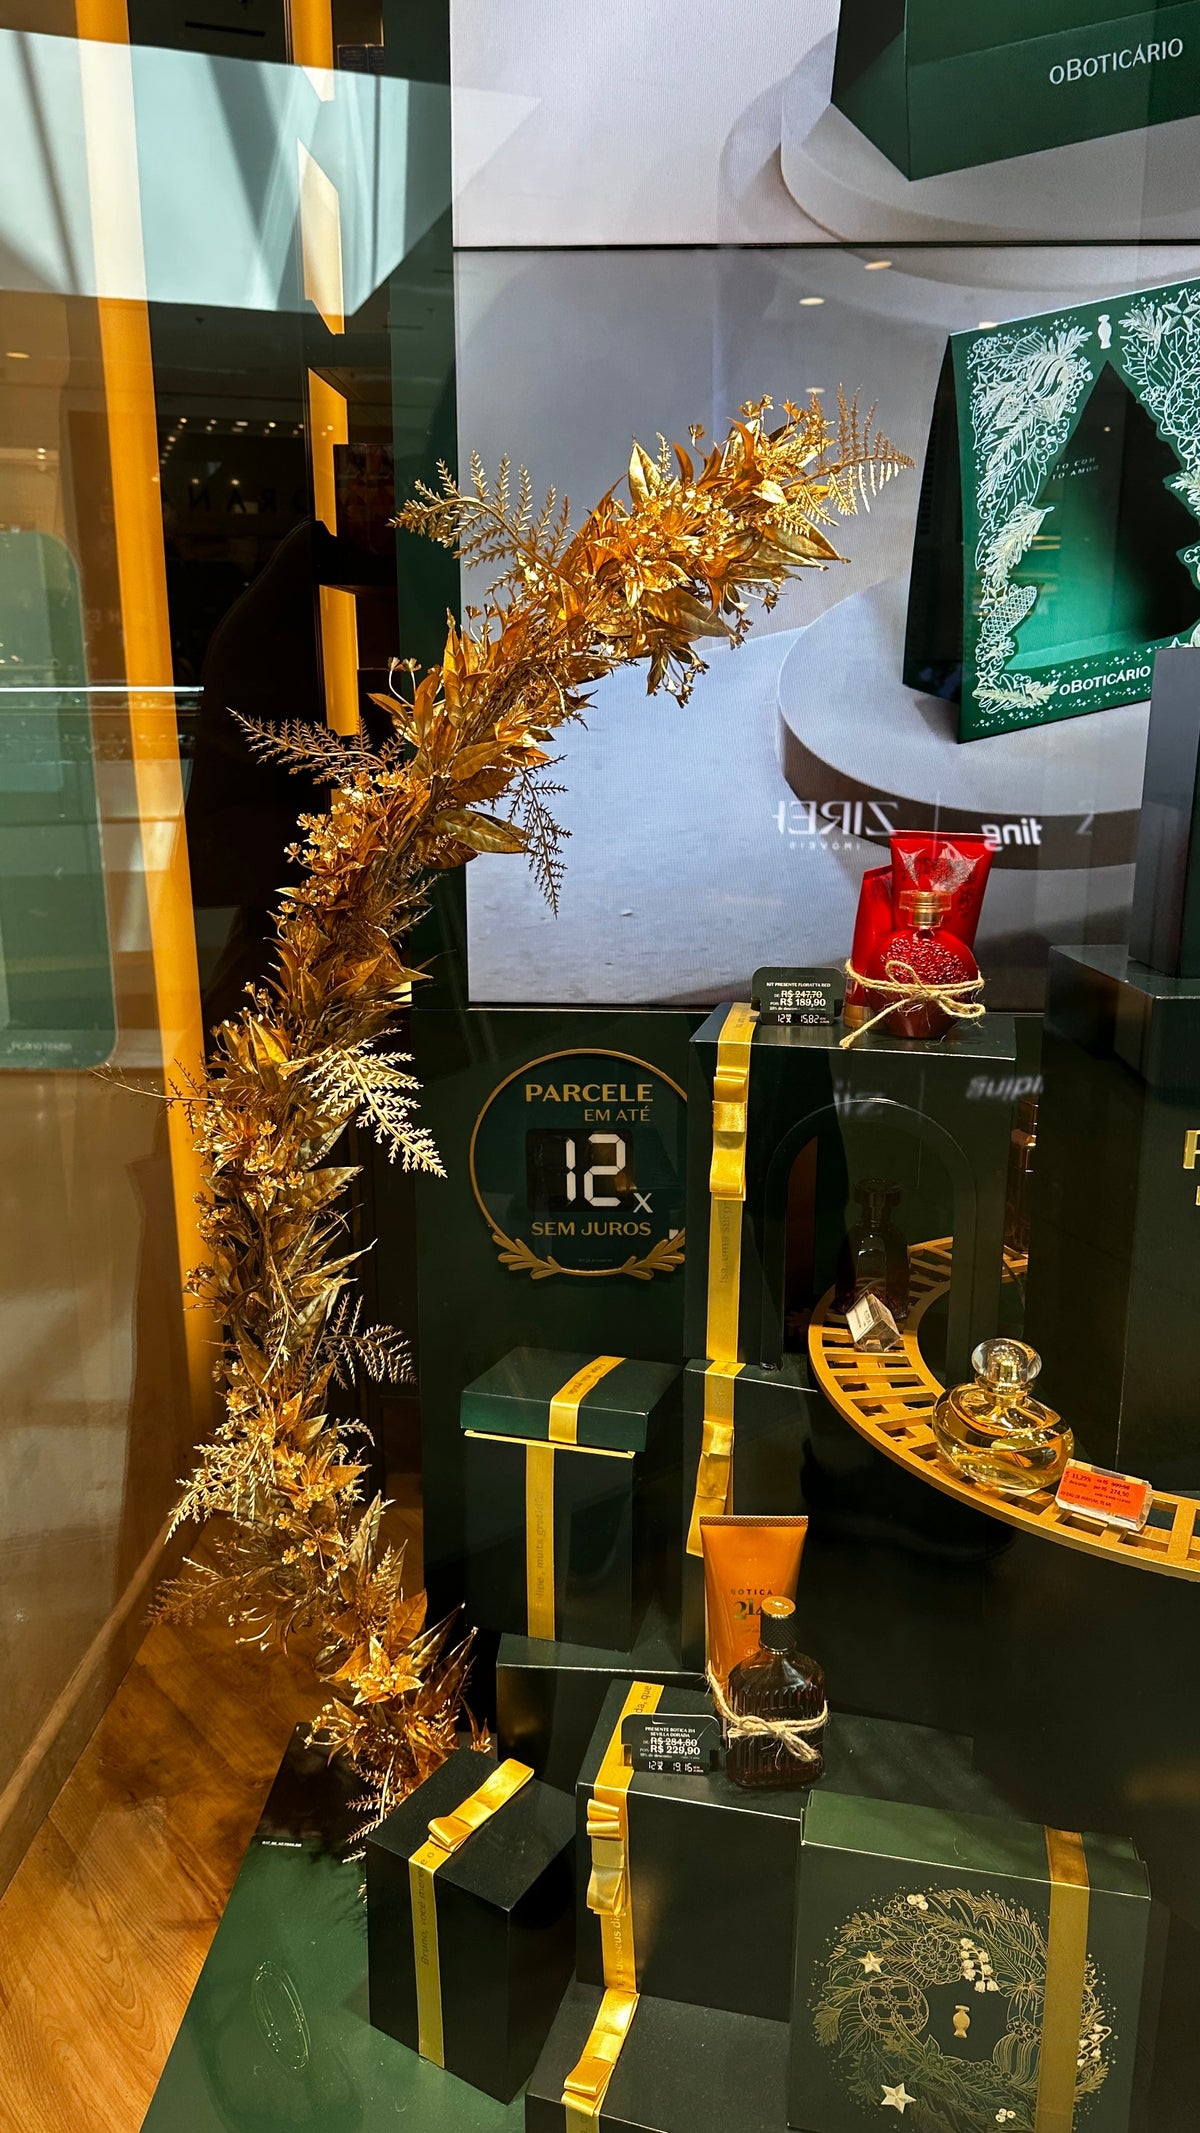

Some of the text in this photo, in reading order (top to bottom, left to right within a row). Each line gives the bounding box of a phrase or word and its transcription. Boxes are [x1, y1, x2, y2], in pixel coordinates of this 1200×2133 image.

[781, 990, 793, 999] R$
[795, 990, 823, 999] 247,70
[780, 998, 793, 1007] R$
[795, 998, 826, 1008] 189,90
[525, 1083, 653, 1103] PARCELE
[584, 1105, 651, 1122] EM ATÉ
[531, 1221, 652, 1236] SEM JUROS
[641, 1685, 652, 1700] que
[650, 1737, 664, 1745] R$
[665, 1737, 698, 1747] 284,80
[650, 1745, 664, 1754] R$
[666, 1745, 701, 1756] 229,90
